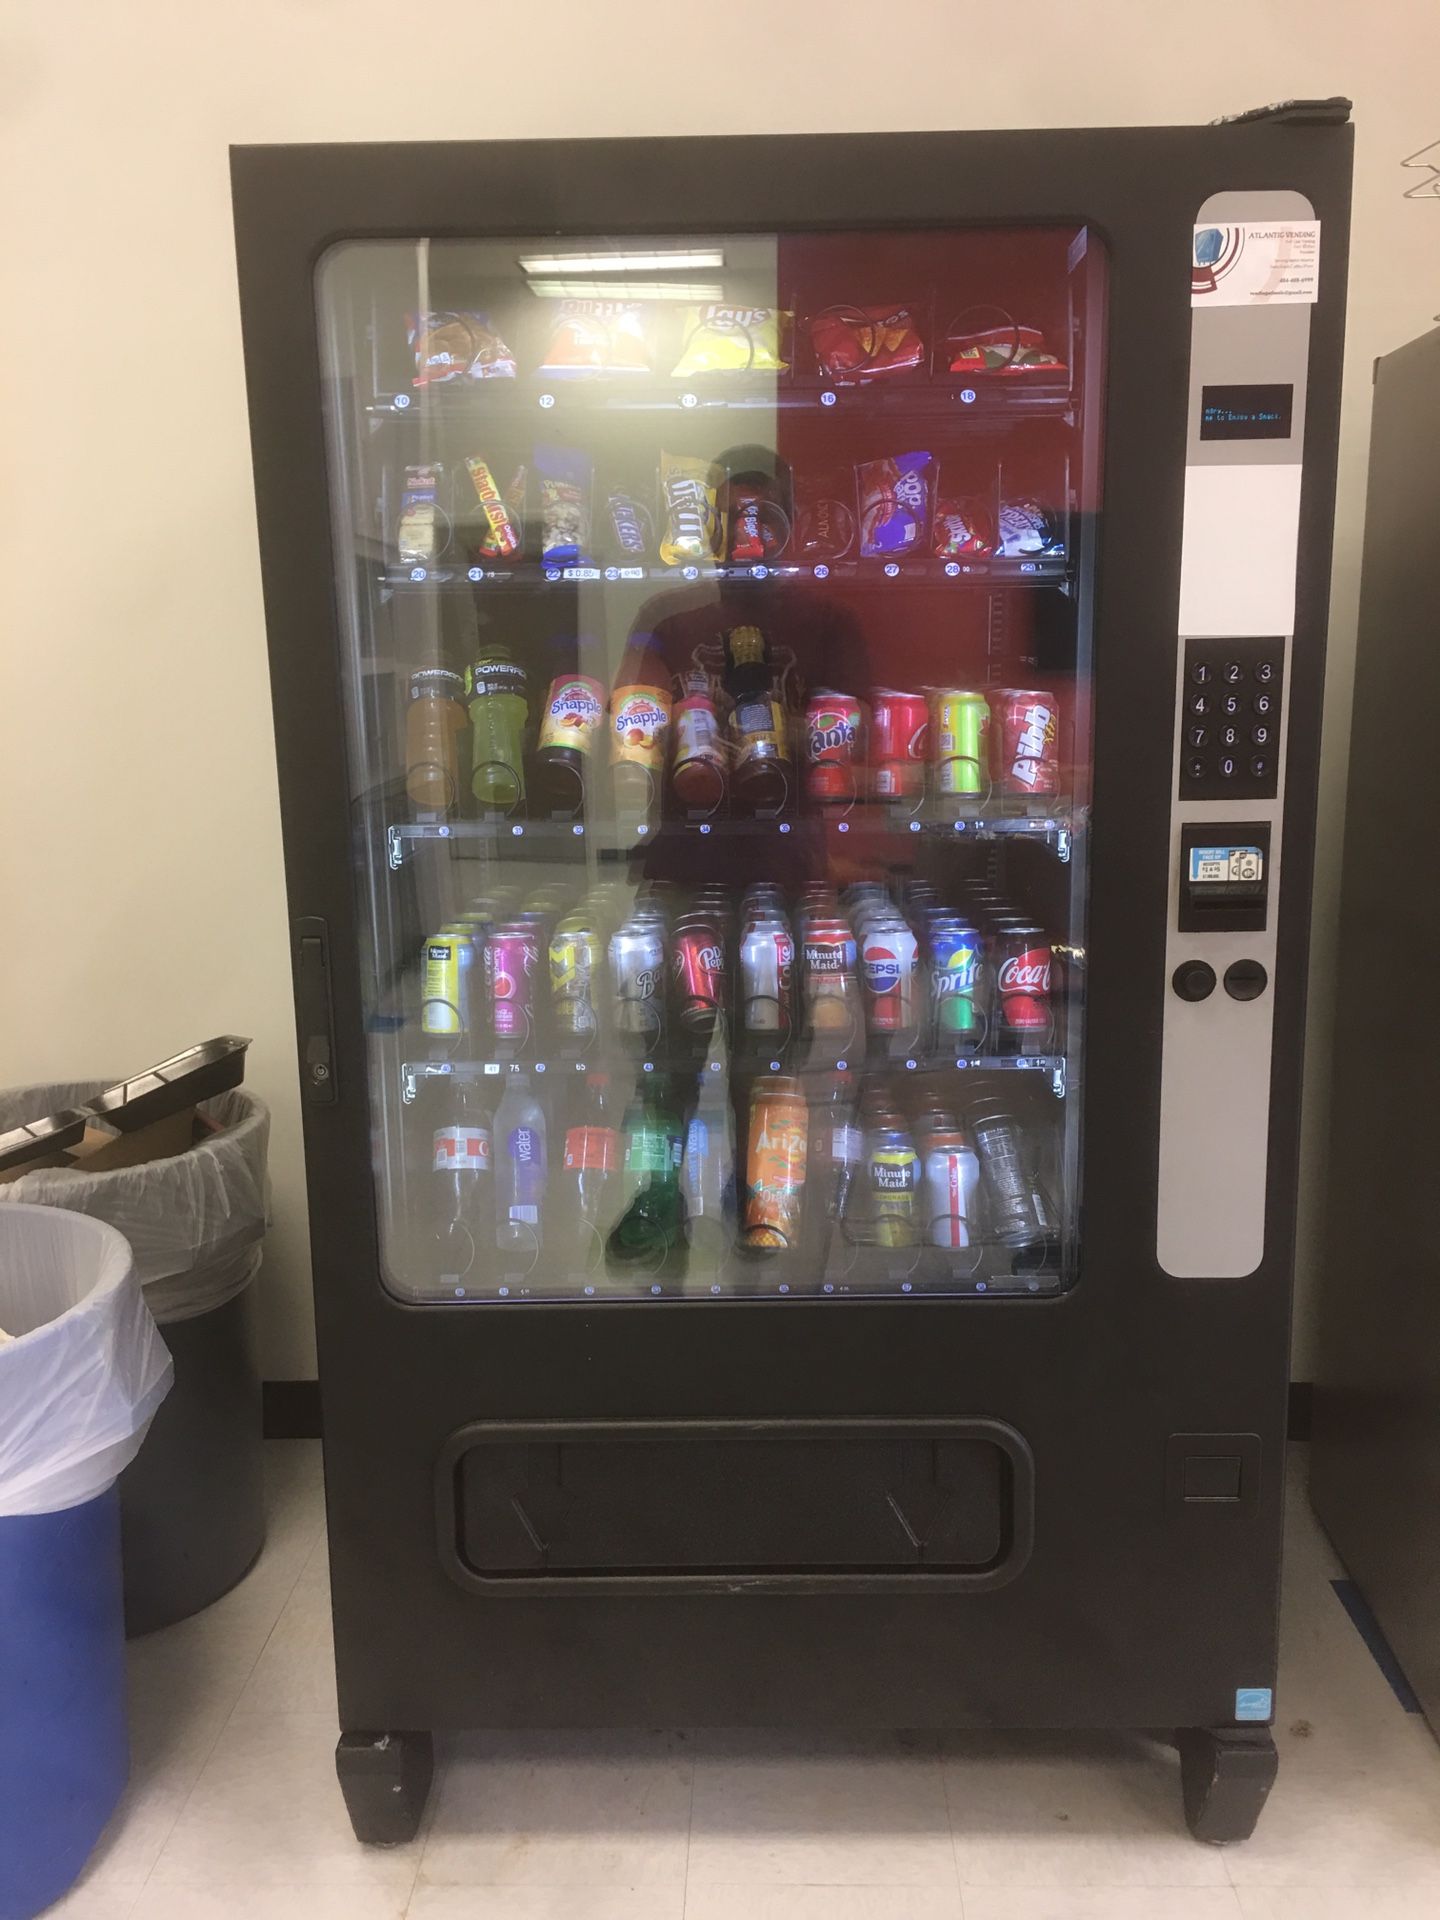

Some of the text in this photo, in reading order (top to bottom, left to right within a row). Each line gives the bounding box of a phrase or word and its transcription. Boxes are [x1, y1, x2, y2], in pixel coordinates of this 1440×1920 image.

[1248, 230, 1316, 239] ATLANTIC VENDING
[1199, 664, 1271, 681] 1 2 3
[1195, 696, 1269, 712] 4 5 6
[616, 707, 667, 731] Snapple
[1195, 727, 1267, 744] 7 8 9
[1012, 704, 1051, 787] Pibb
[1224, 759, 1233, 774] 0
[806, 947, 843, 960] Minute
[810, 959, 837, 970] Maid
[931, 957, 985, 999] Sprite
[509, 1064, 520, 1073] 75
[515, 1128, 532, 1162] water
[874, 1165, 911, 1178] Minute
[878, 1178, 906, 1188] Maid
